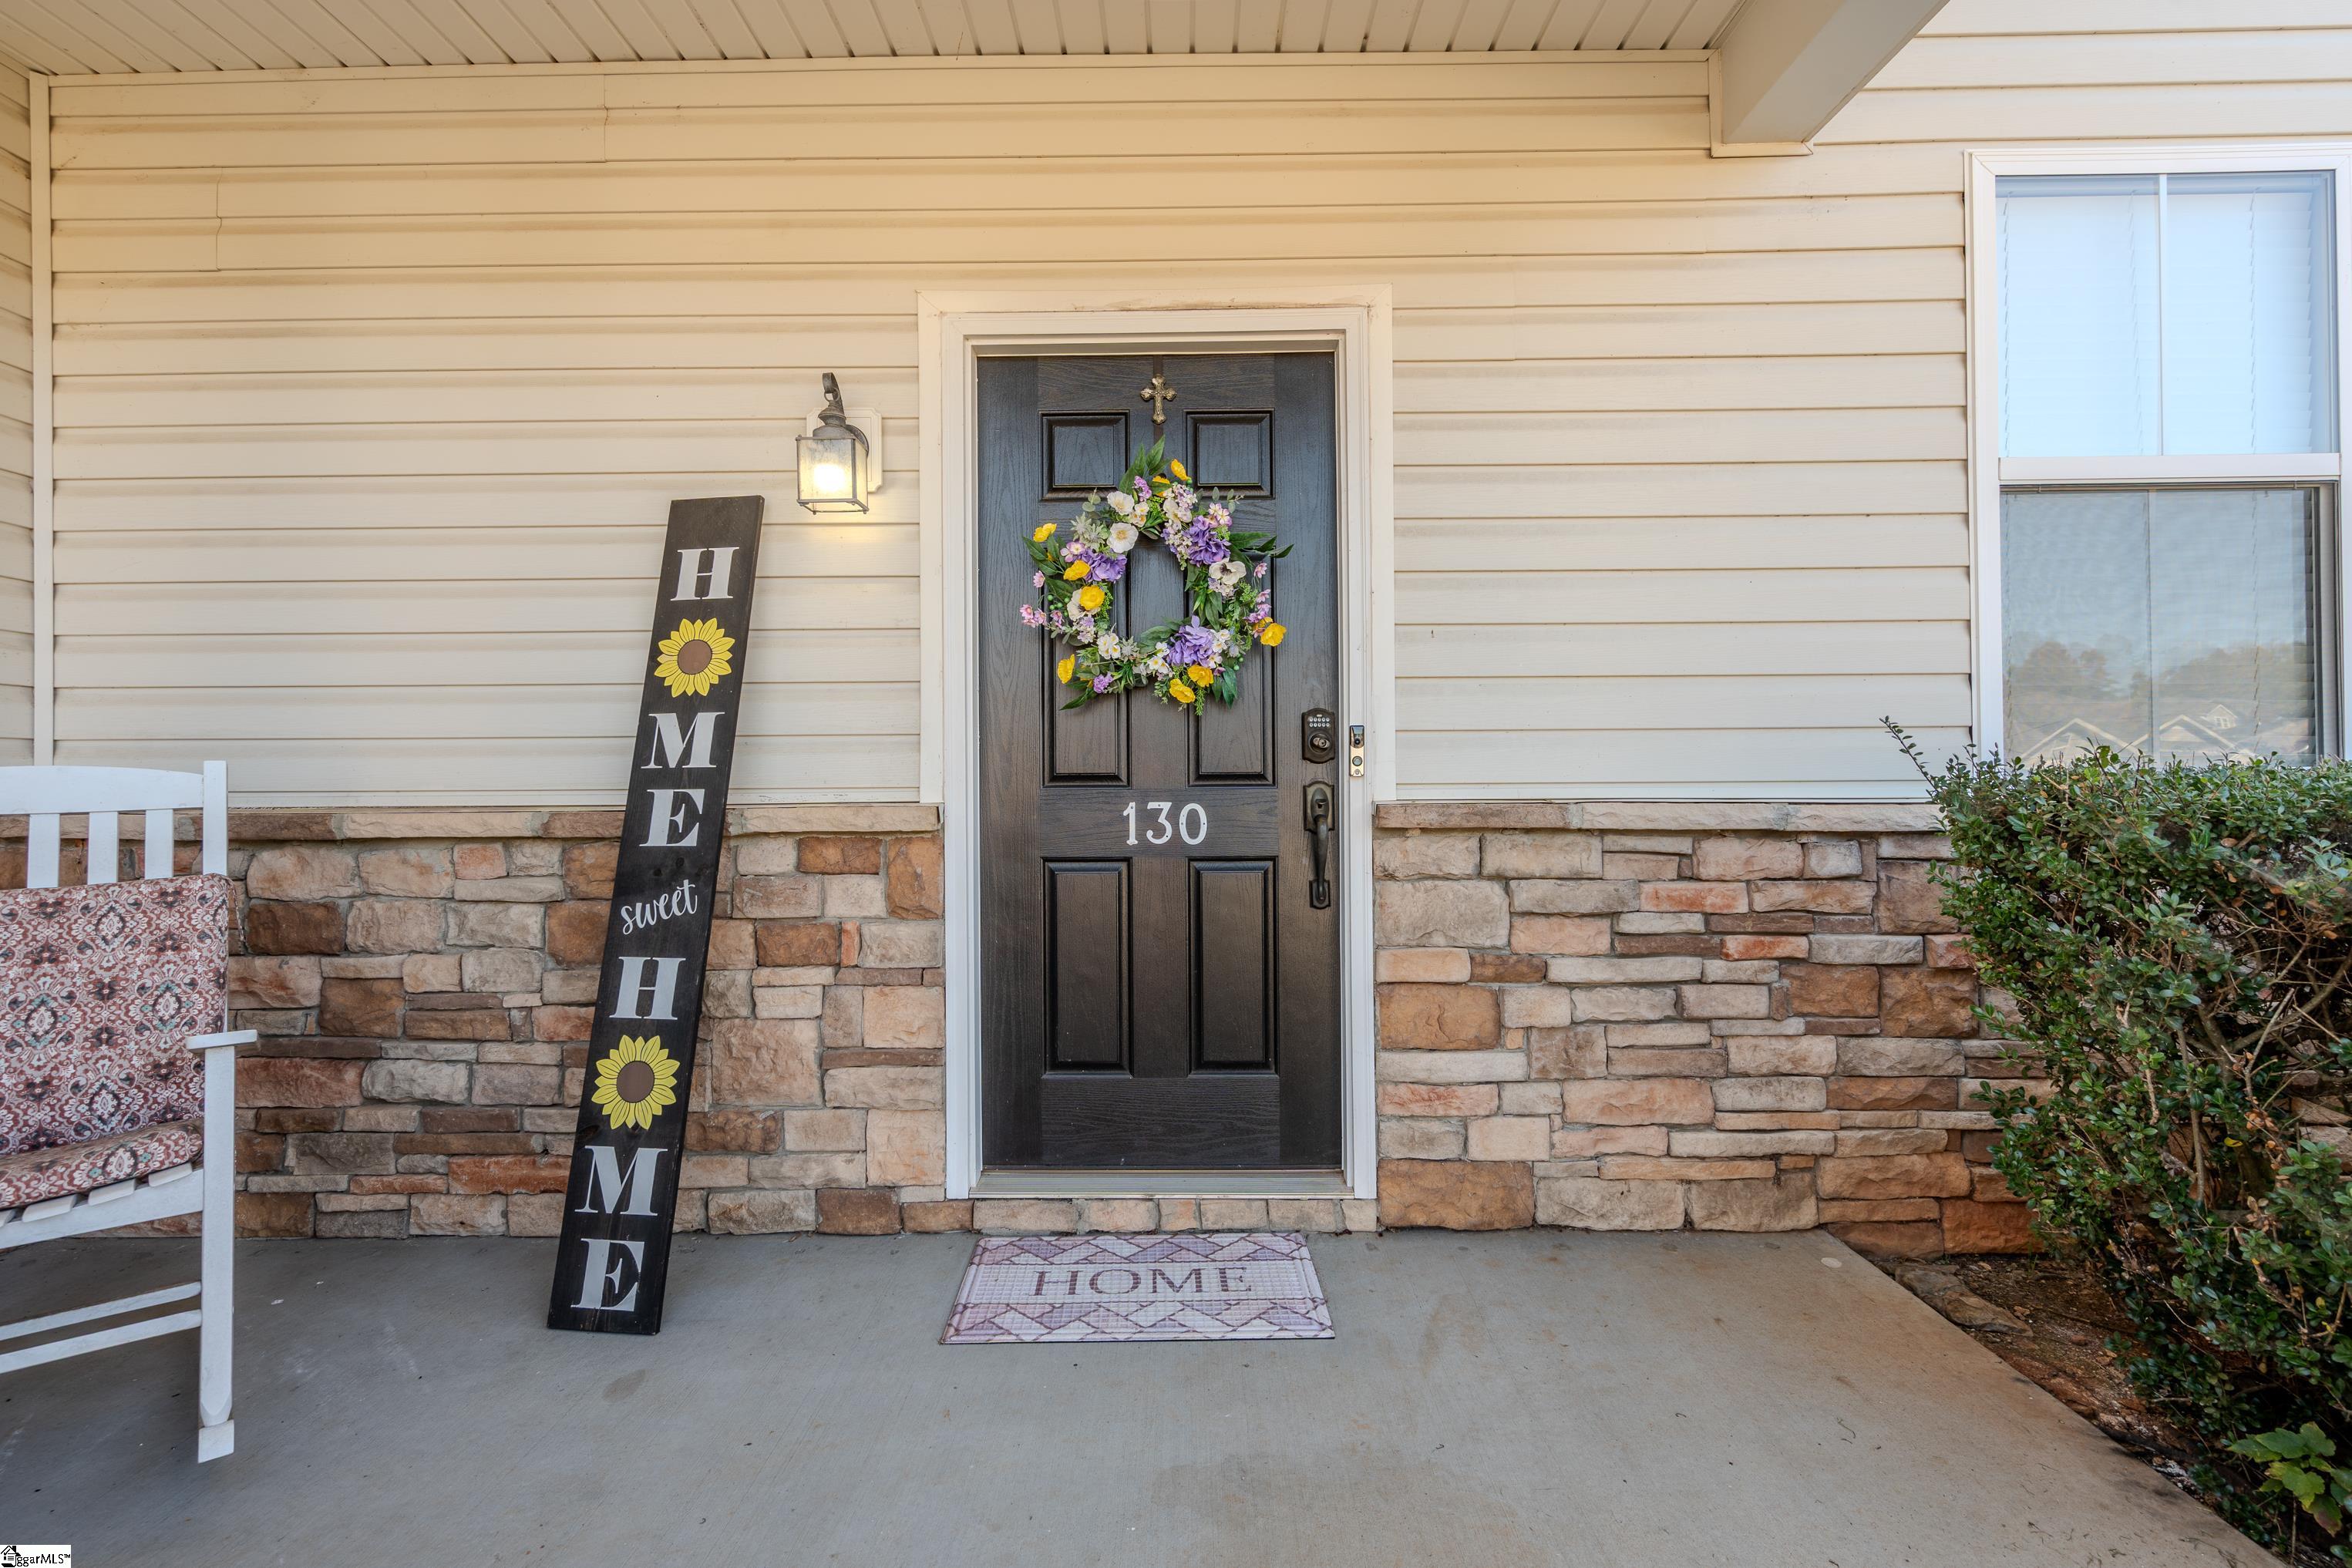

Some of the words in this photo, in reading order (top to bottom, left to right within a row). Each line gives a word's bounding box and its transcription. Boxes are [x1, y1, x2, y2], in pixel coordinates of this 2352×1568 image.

[1122, 801, 1208, 846] 130
[621, 879, 698, 935] sweet
[1031, 1266, 1253, 1297] HOME
